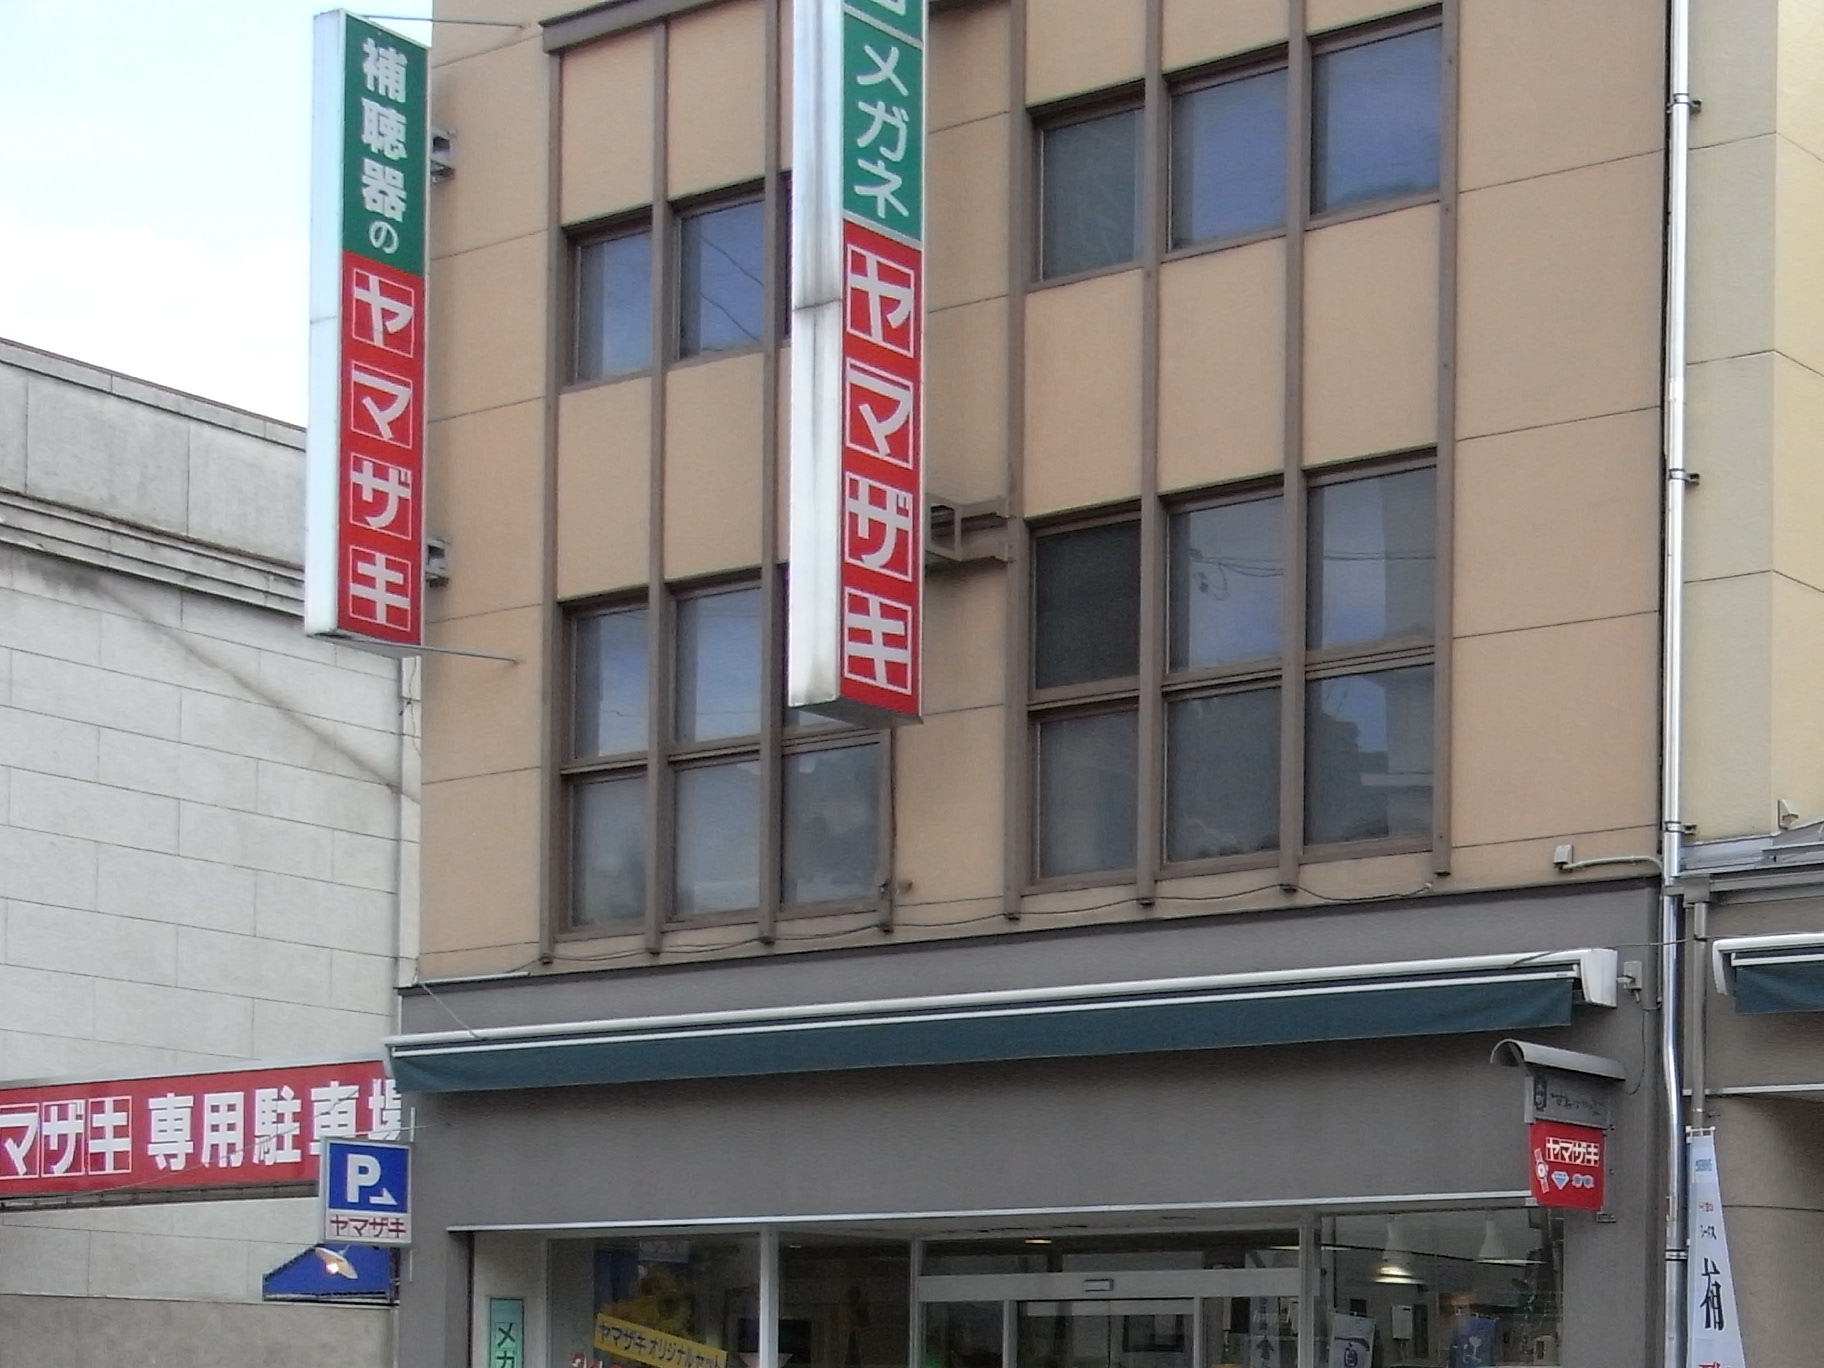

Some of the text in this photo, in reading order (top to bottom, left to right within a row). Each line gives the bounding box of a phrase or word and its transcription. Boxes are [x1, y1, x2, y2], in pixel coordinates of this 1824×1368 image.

[361, 37, 408, 255] 補聴器の
[349, 268, 414, 632] ヤマザキ
[846, 244, 914, 694] ヤマザキ
[1546, 1137, 1599, 1167] ヤマザキ
[346, 1154, 381, 1203] P
[330, 1215, 406, 1240] ヤマザキ
[600, 1323, 647, 1351] ヤマザキ
